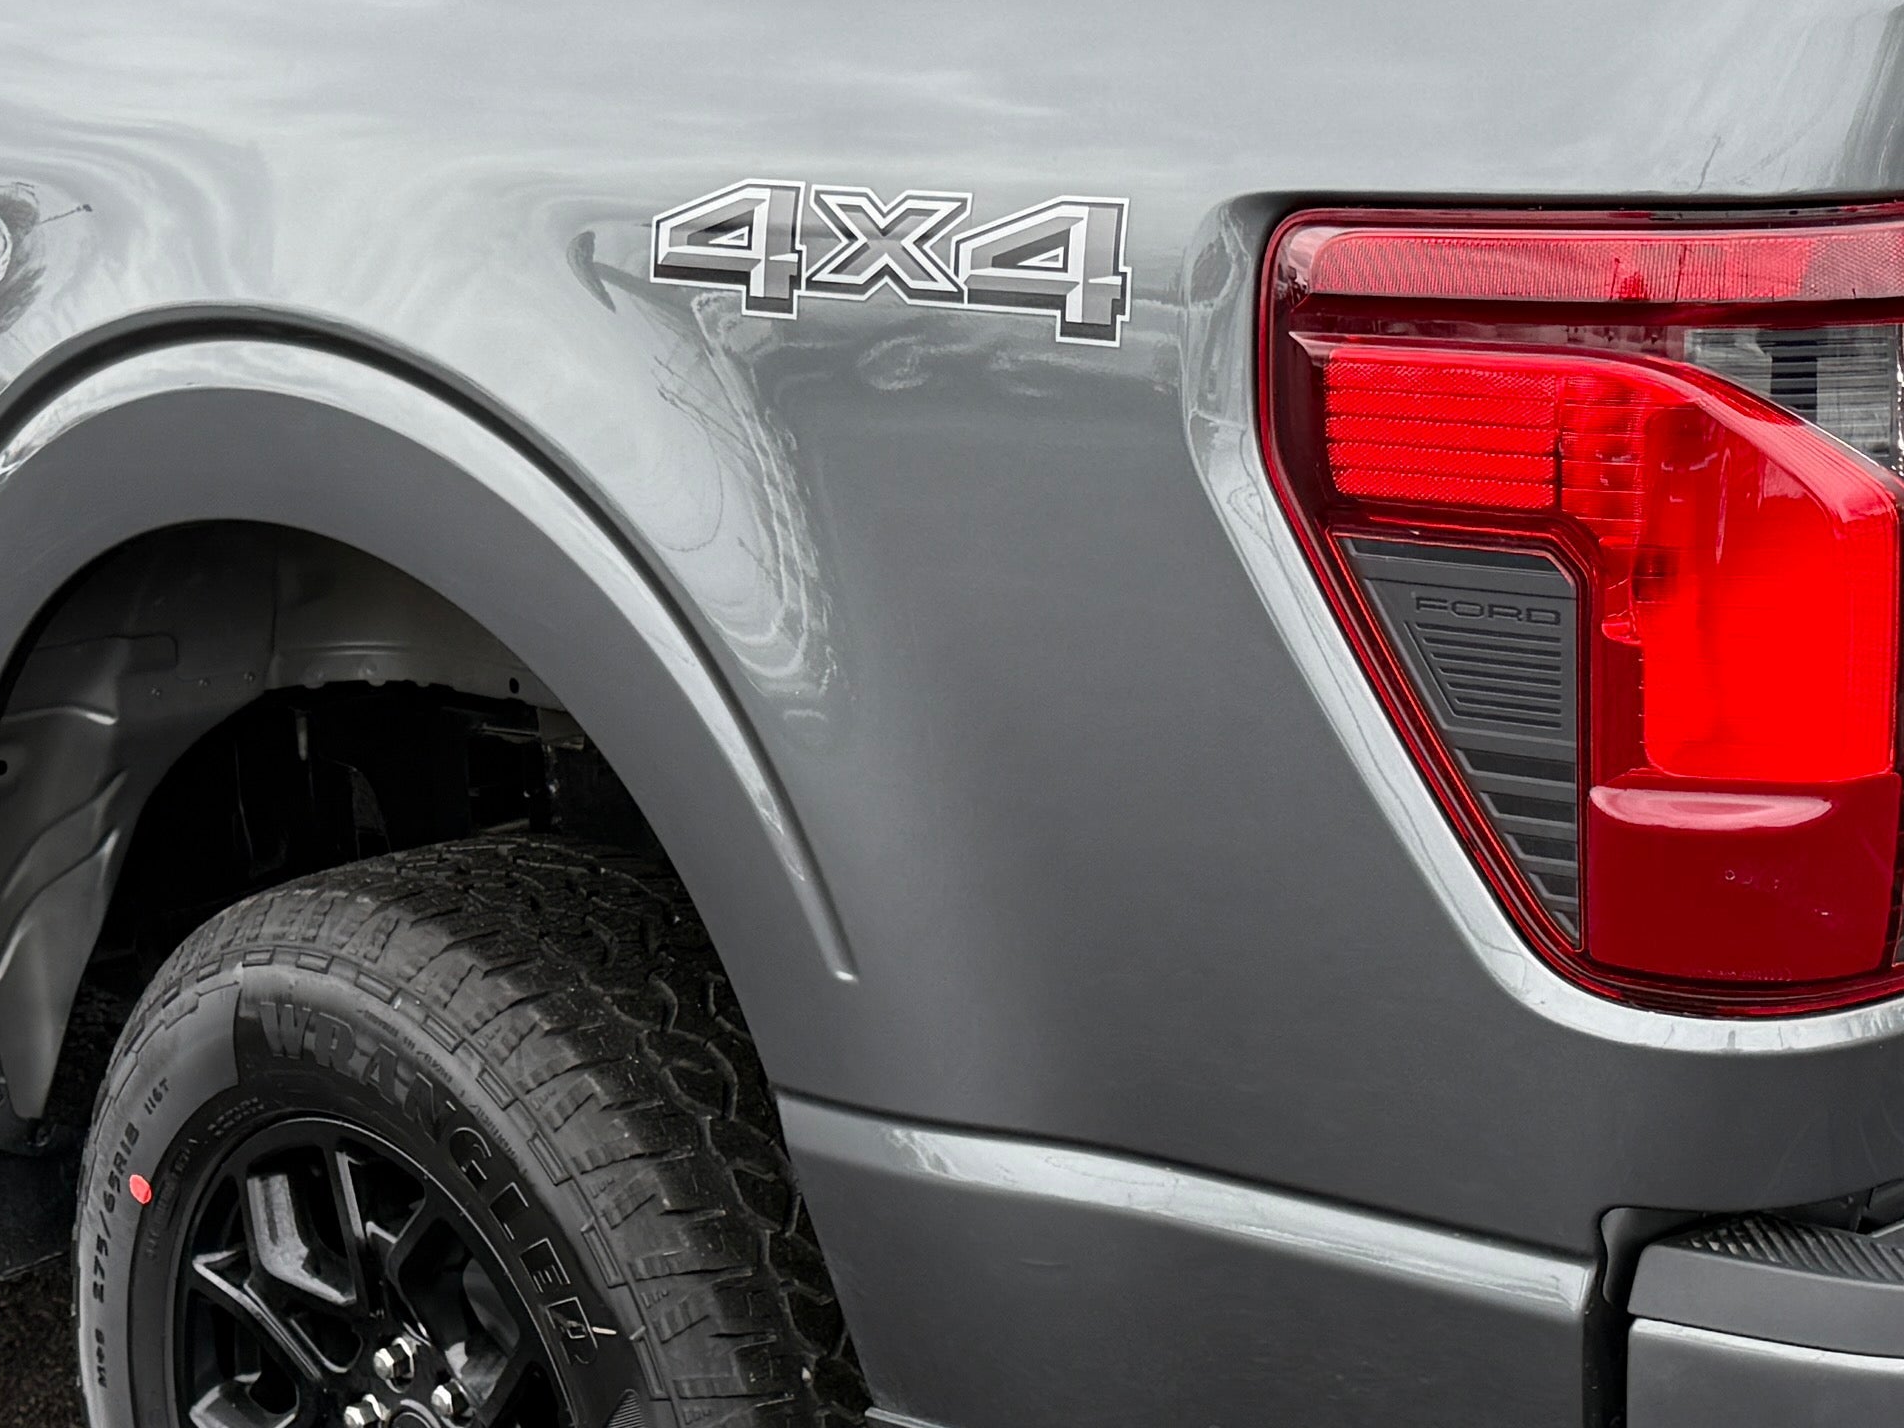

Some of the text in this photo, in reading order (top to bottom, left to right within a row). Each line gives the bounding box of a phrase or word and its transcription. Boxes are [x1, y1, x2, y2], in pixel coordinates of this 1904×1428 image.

[1415, 596, 1562, 627] FORD
[144, 1077, 170, 1116] 116T
[259, 1000, 599, 1367] WRANGLER
